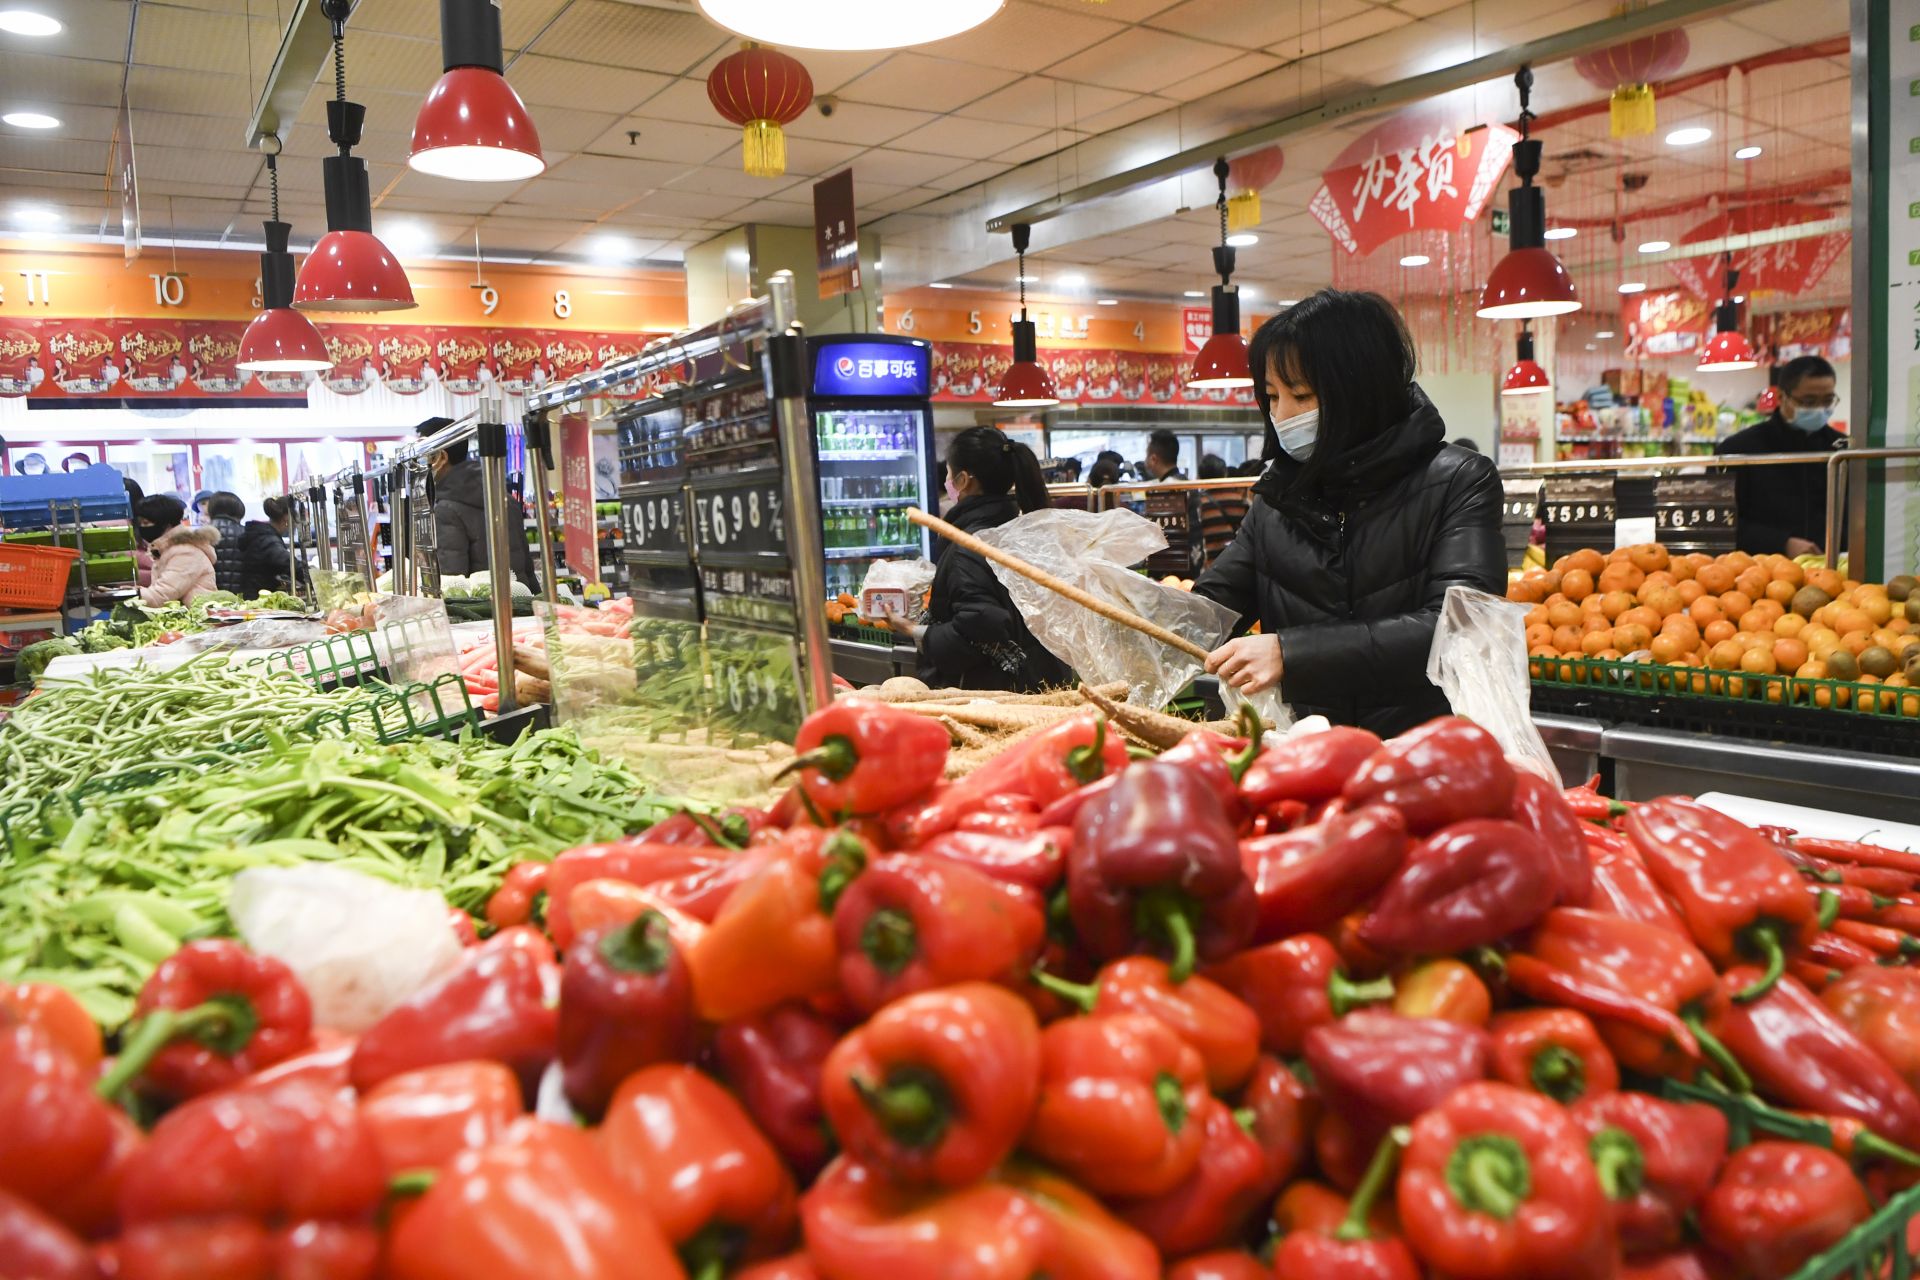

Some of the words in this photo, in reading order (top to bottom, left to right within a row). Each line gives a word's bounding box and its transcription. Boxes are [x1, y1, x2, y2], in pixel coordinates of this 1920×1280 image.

[1352, 127, 1458, 227] 办年货
[19, 272, 49, 303] 11
[149, 274, 184, 305] 10
[480, 288, 499, 315] 9
[554, 290, 572, 318] 8
[900, 309, 915, 331] 6
[969, 310, 983, 335] 5
[1133, 320, 1145, 341] 4
[858, 359, 917, 378] 百事可乐
[697, 491, 761, 545] ¥6.98
[1547, 505, 1599, 523] ¥5.98
[1657, 509, 1716, 528] ¥6.58
